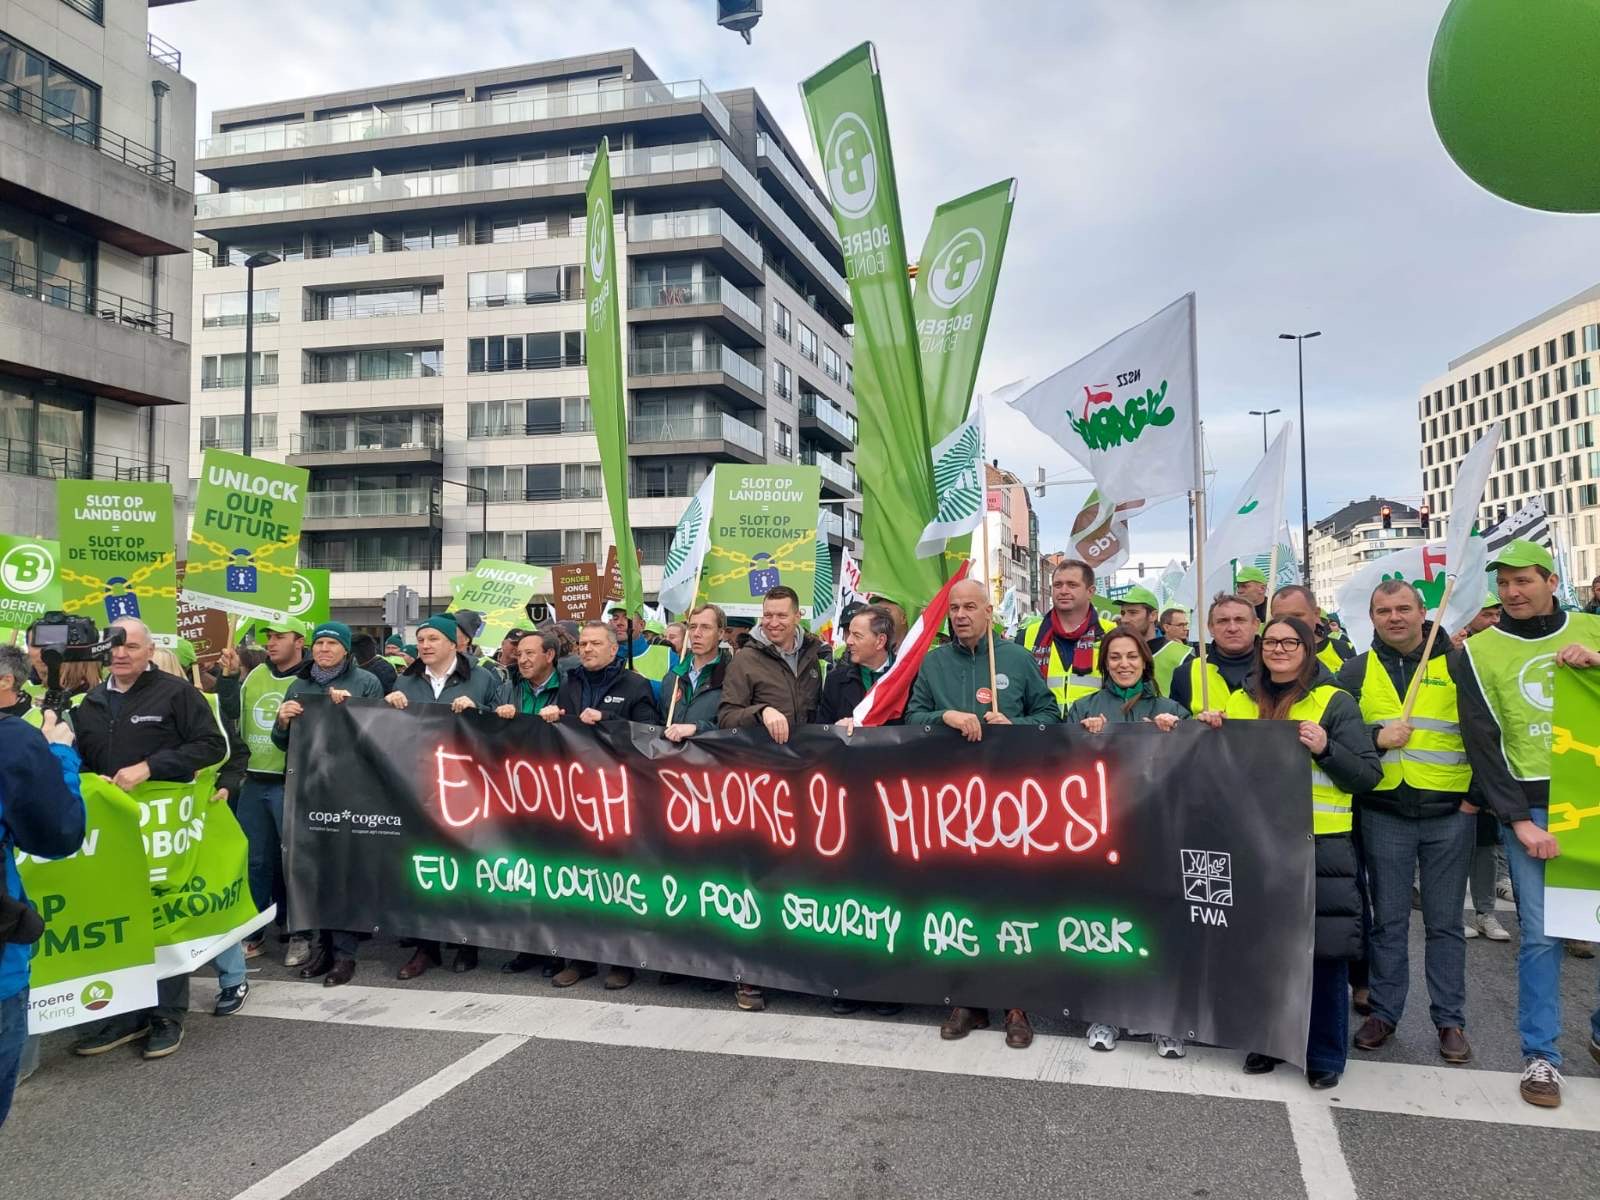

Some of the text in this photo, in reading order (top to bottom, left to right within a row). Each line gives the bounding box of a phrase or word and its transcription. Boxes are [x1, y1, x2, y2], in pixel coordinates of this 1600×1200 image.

[208, 466, 298, 503] UNLOCK
[741, 478, 792, 489] SLOT OP
[86, 494, 143, 508] SLOT OP
[729, 490, 803, 501] LANDBOUW
[226, 493, 273, 519] OUR
[74, 508, 156, 522] LANDBOUW
[739, 514, 791, 526] SLOT OP
[204, 508, 289, 544] FUTURE
[720, 526, 808, 539] DE TOEKOMST
[88, 536, 145, 548] SLOT OP
[69, 548, 166, 563] DE TOEKOMST
[476, 567, 538, 586] UNLOCK
[560, 575, 590, 584] ZONDER
[482, 580, 515, 595] OUR
[564, 584, 588, 593] JONGE
[462, 590, 520, 608] FUTURE
[562, 593, 592, 602] BOEREN
[181, 628, 204, 639] HET
[435, 745, 631, 840] ENOUGH
[658, 769, 796, 847] SMOKE
[875, 761, 1119, 864] MIRRORS!
[412, 855, 460, 890] EU
[700, 881, 761, 929] FOOD
[923, 912, 980, 957] ARE
[996, 921, 1039, 955] AT
[1059, 917, 1149, 957] RISK.
[1191, 905, 1229, 928] FWA
[39, 1006, 76, 1022] Kring
